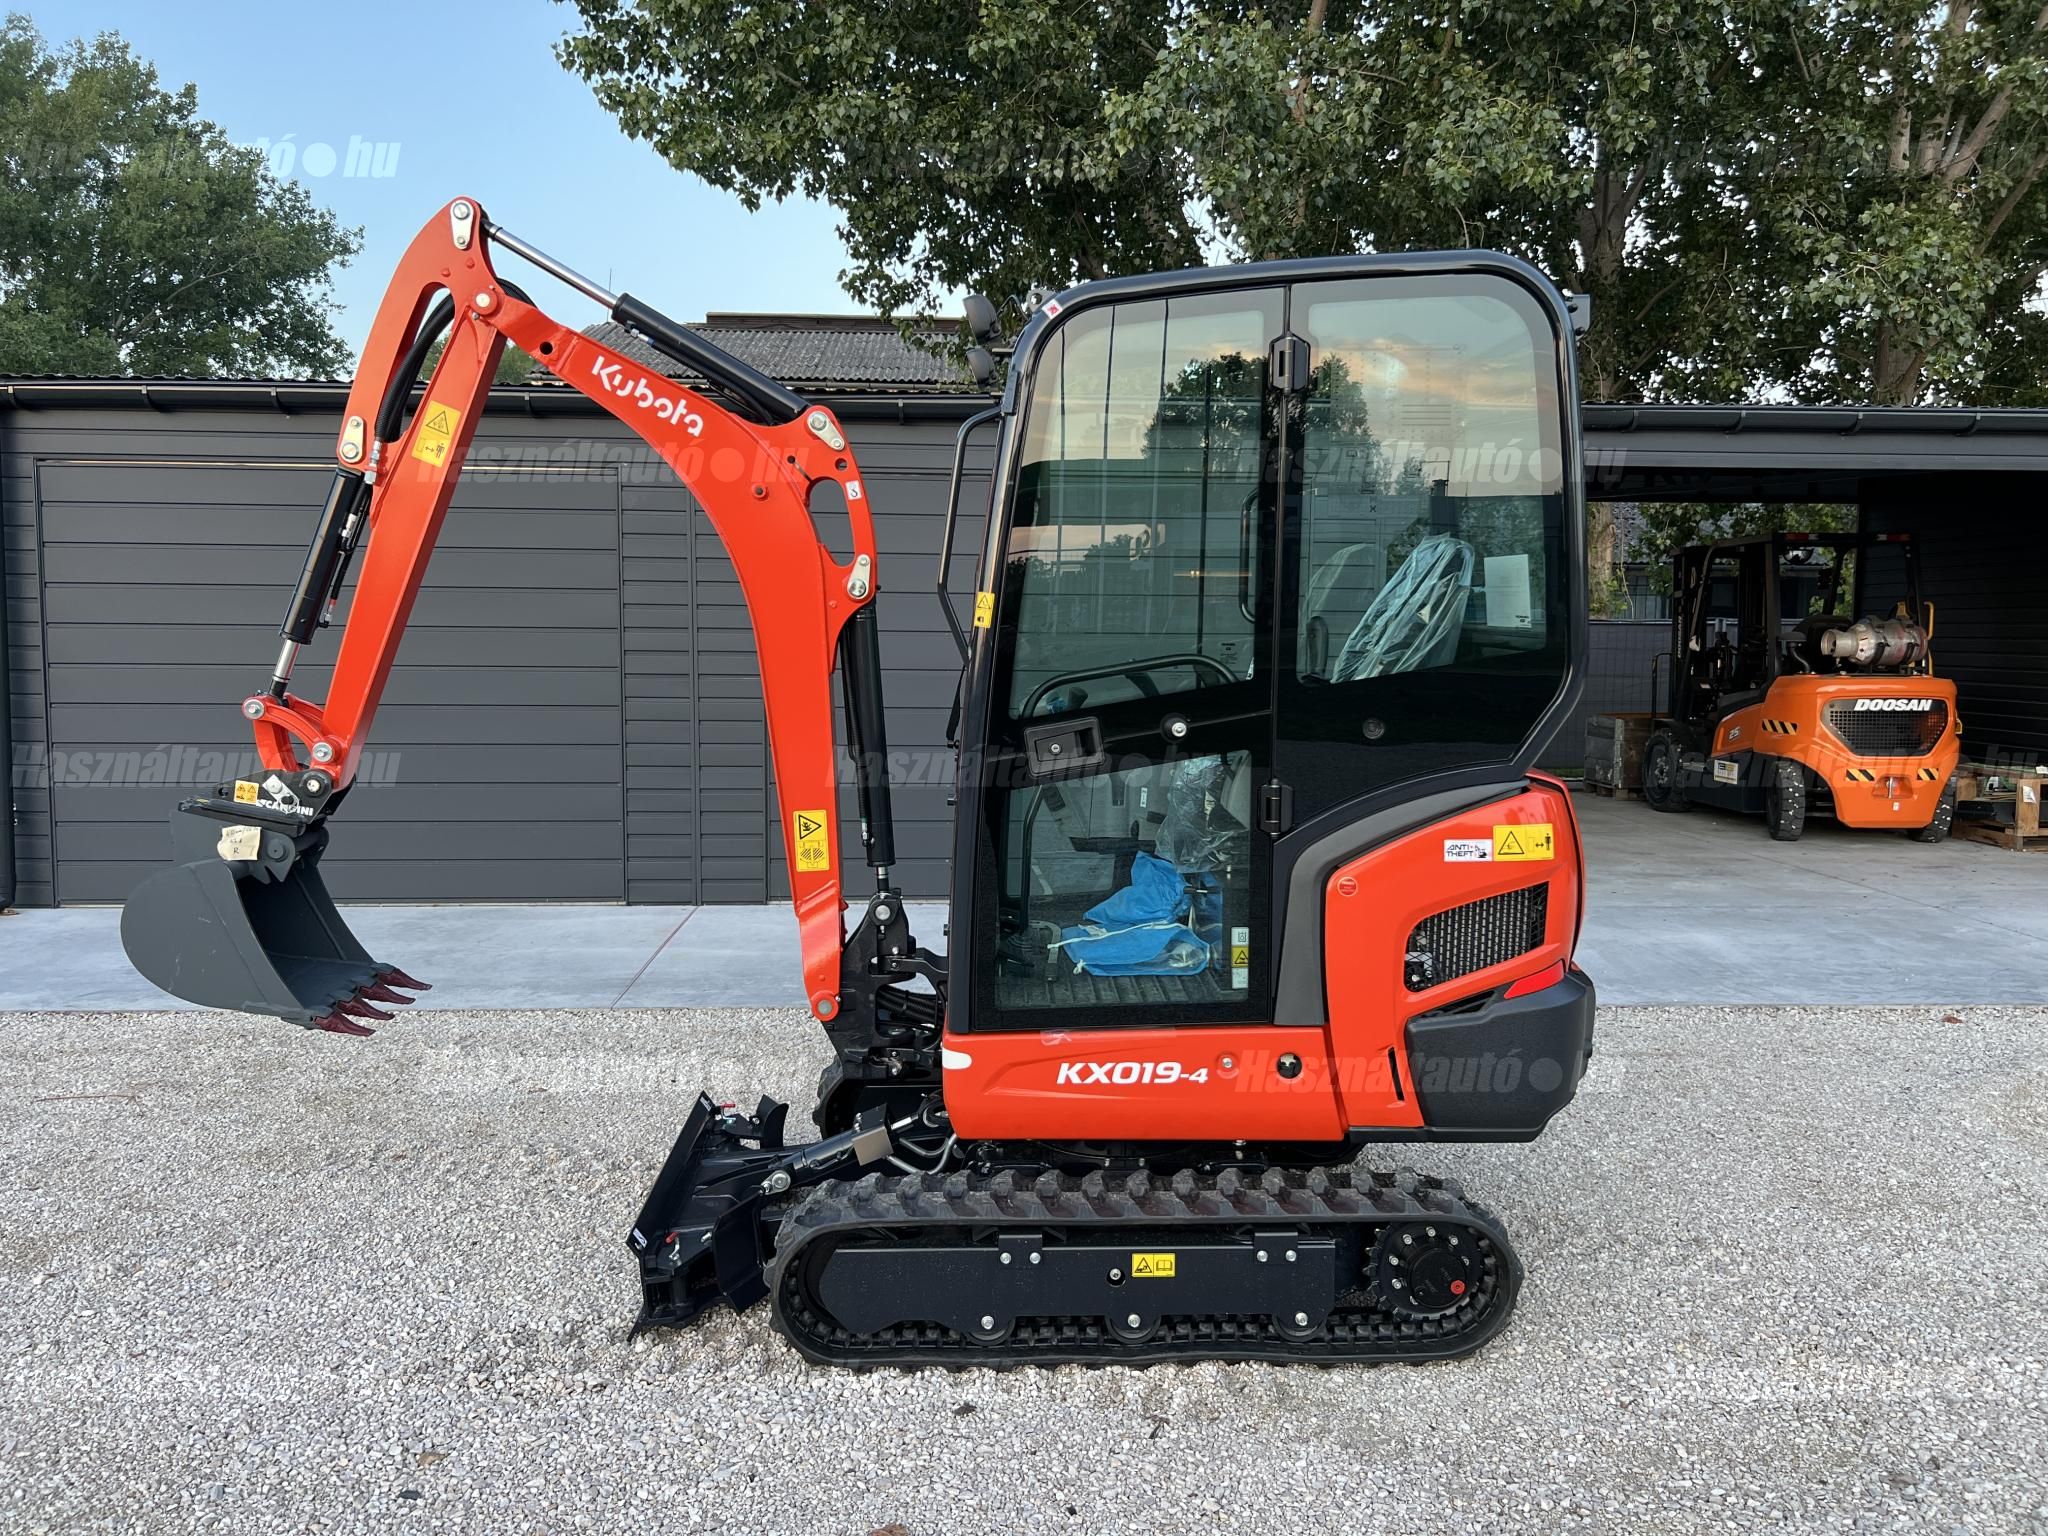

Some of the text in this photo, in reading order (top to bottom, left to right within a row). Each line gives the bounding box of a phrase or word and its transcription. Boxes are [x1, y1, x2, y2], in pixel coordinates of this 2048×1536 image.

[592, 356, 703, 437] Kubota
[1854, 699, 1932, 711] DOOSAN
[1057, 1062, 1208, 1084] KX019-4
